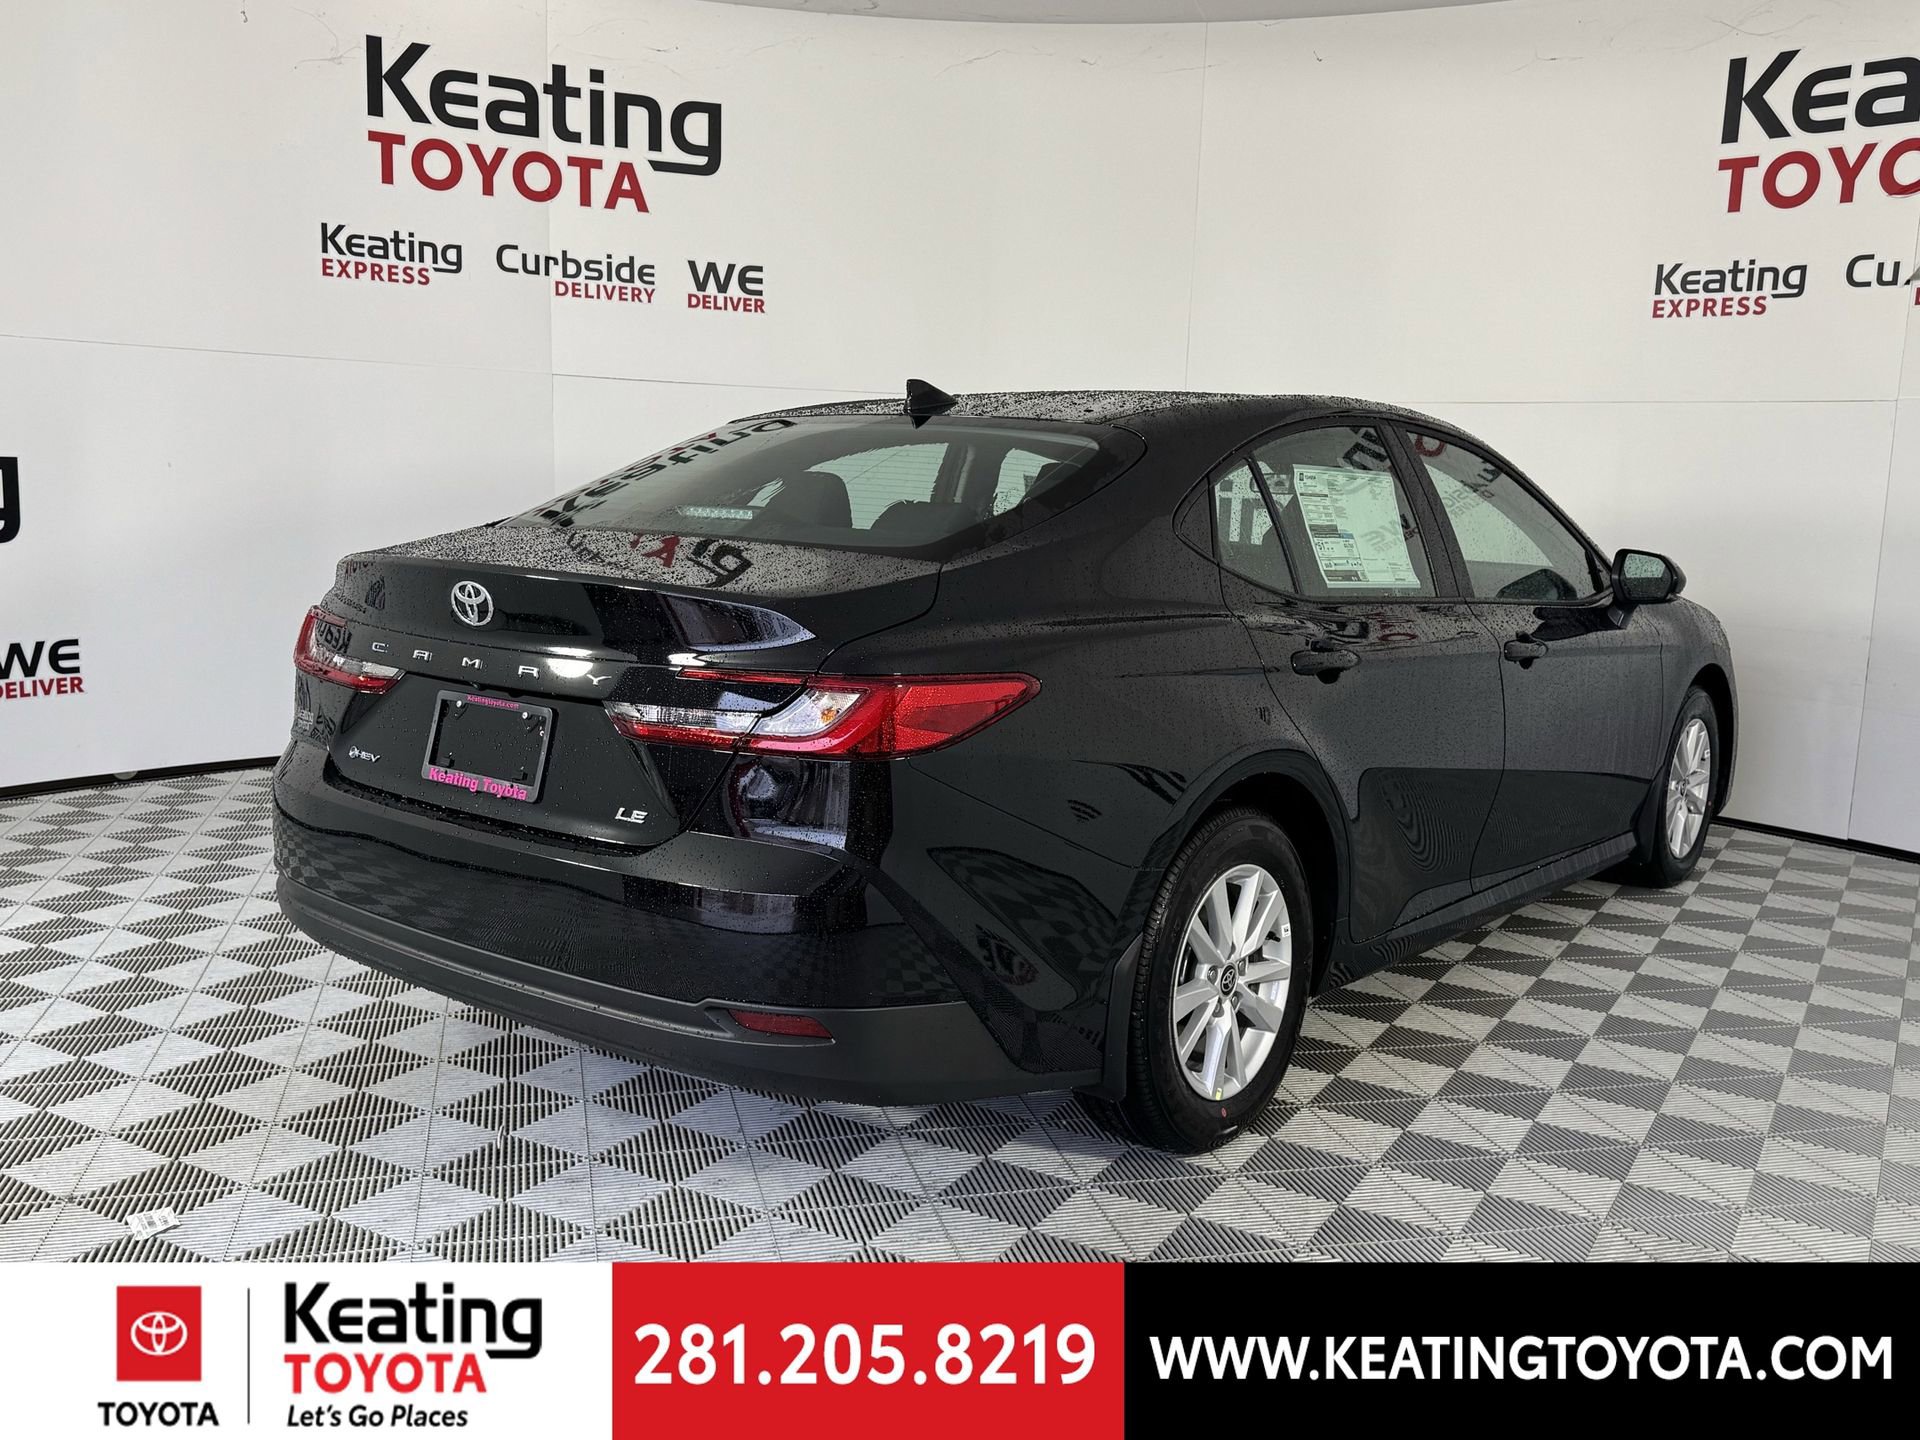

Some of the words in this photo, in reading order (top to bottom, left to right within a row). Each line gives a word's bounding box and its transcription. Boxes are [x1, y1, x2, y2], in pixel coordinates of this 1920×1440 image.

[366, 35, 721, 176] Keating
[368, 131, 648, 212] TOYOTA
[321, 223, 462, 273] Keating
[497, 245, 654, 285] Curbside
[322, 258, 430, 285] EXPRESS
[688, 260, 763, 296] WE
[1654, 259, 1807, 298] Keating
[1846, 254, 1911, 287] Cu
[555, 280, 653, 303] DELIVERY
[688, 294, 764, 313] DELIVER
[1652, 297, 1767, 318] EXPRESS
[372, 643, 611, 685] CAMRY
[430, 768, 478, 791] Keating
[484, 778, 526, 800] Toyota
[615, 808, 648, 823] LE
